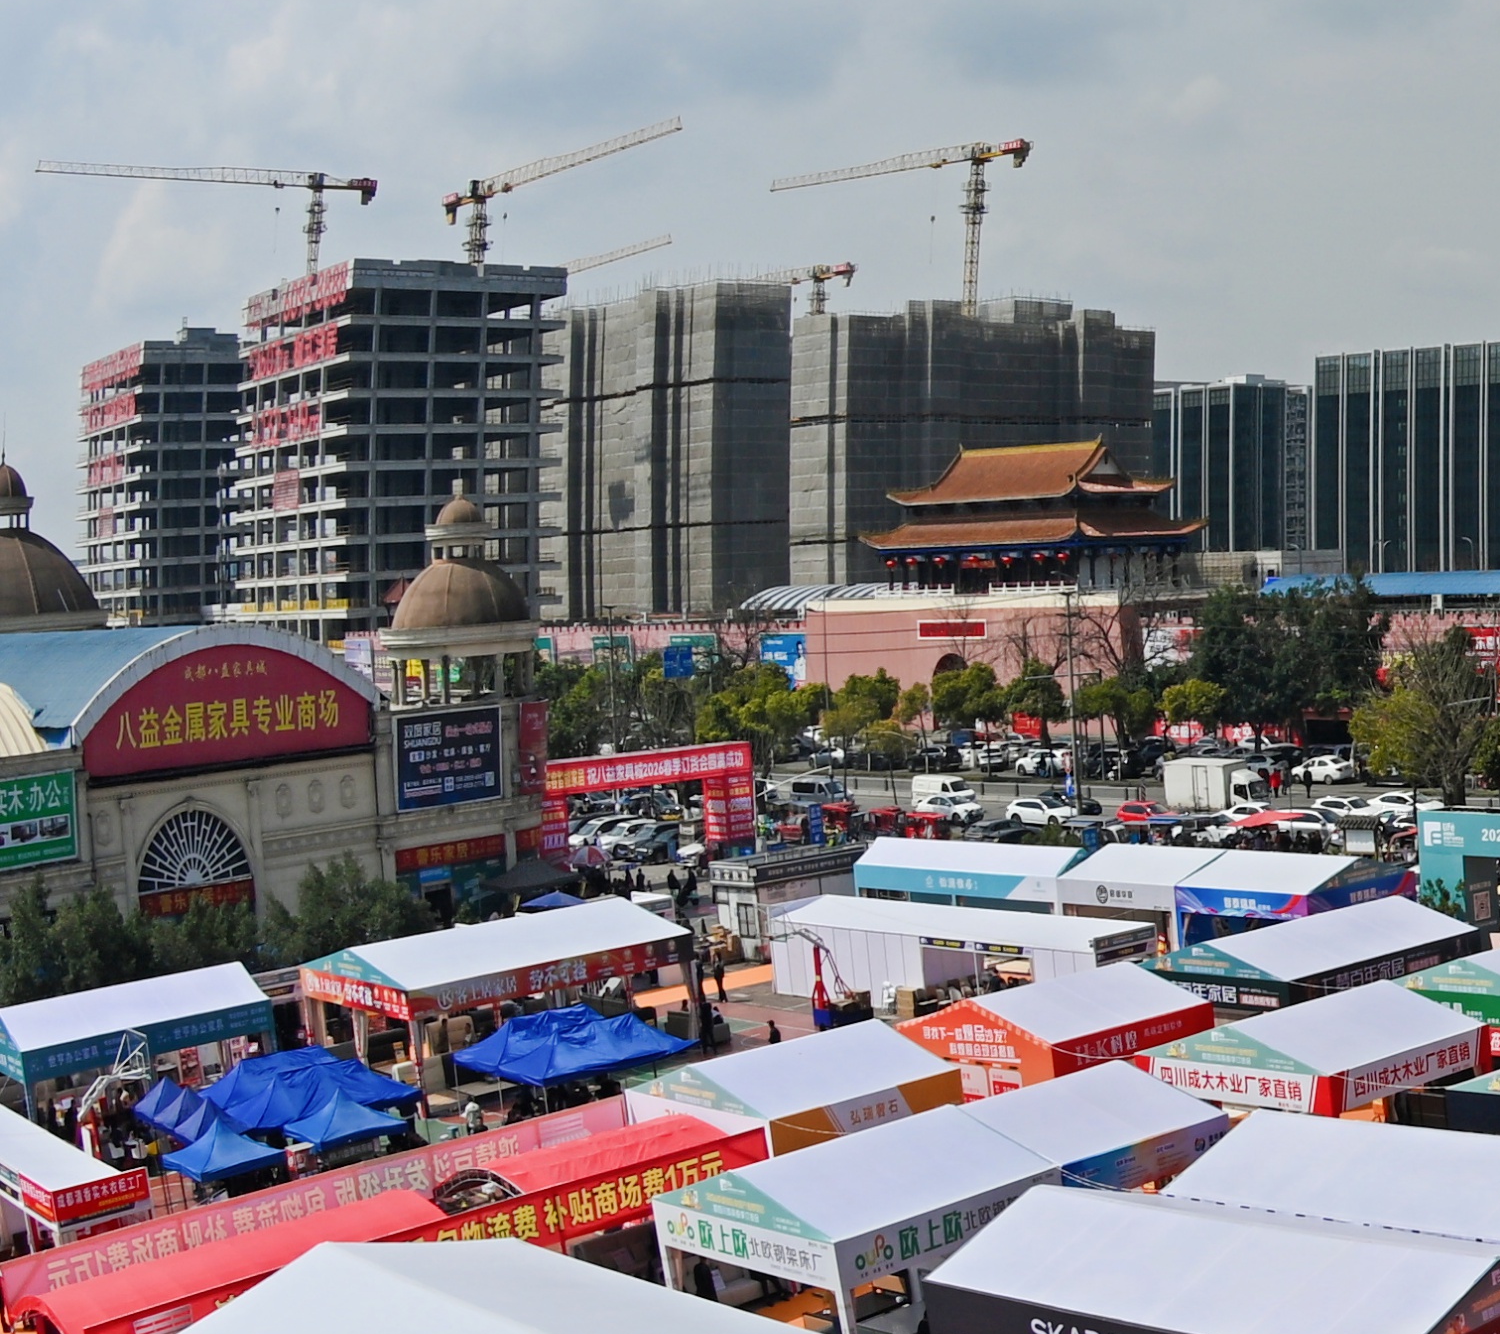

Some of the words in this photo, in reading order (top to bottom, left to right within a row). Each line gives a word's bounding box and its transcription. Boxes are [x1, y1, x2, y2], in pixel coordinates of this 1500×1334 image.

[116, 689, 340, 751] 八益金属家具专业商场
[1160, 1066, 1303, 1102] 四川成大木业厂家直销
[1353, 1041, 1471, 1100] 四川成大木业厂家直销
[545, 1151, 724, 1235] 补贴商场费1万元
[749, 1236, 824, 1272] 北欧钢架床厂
